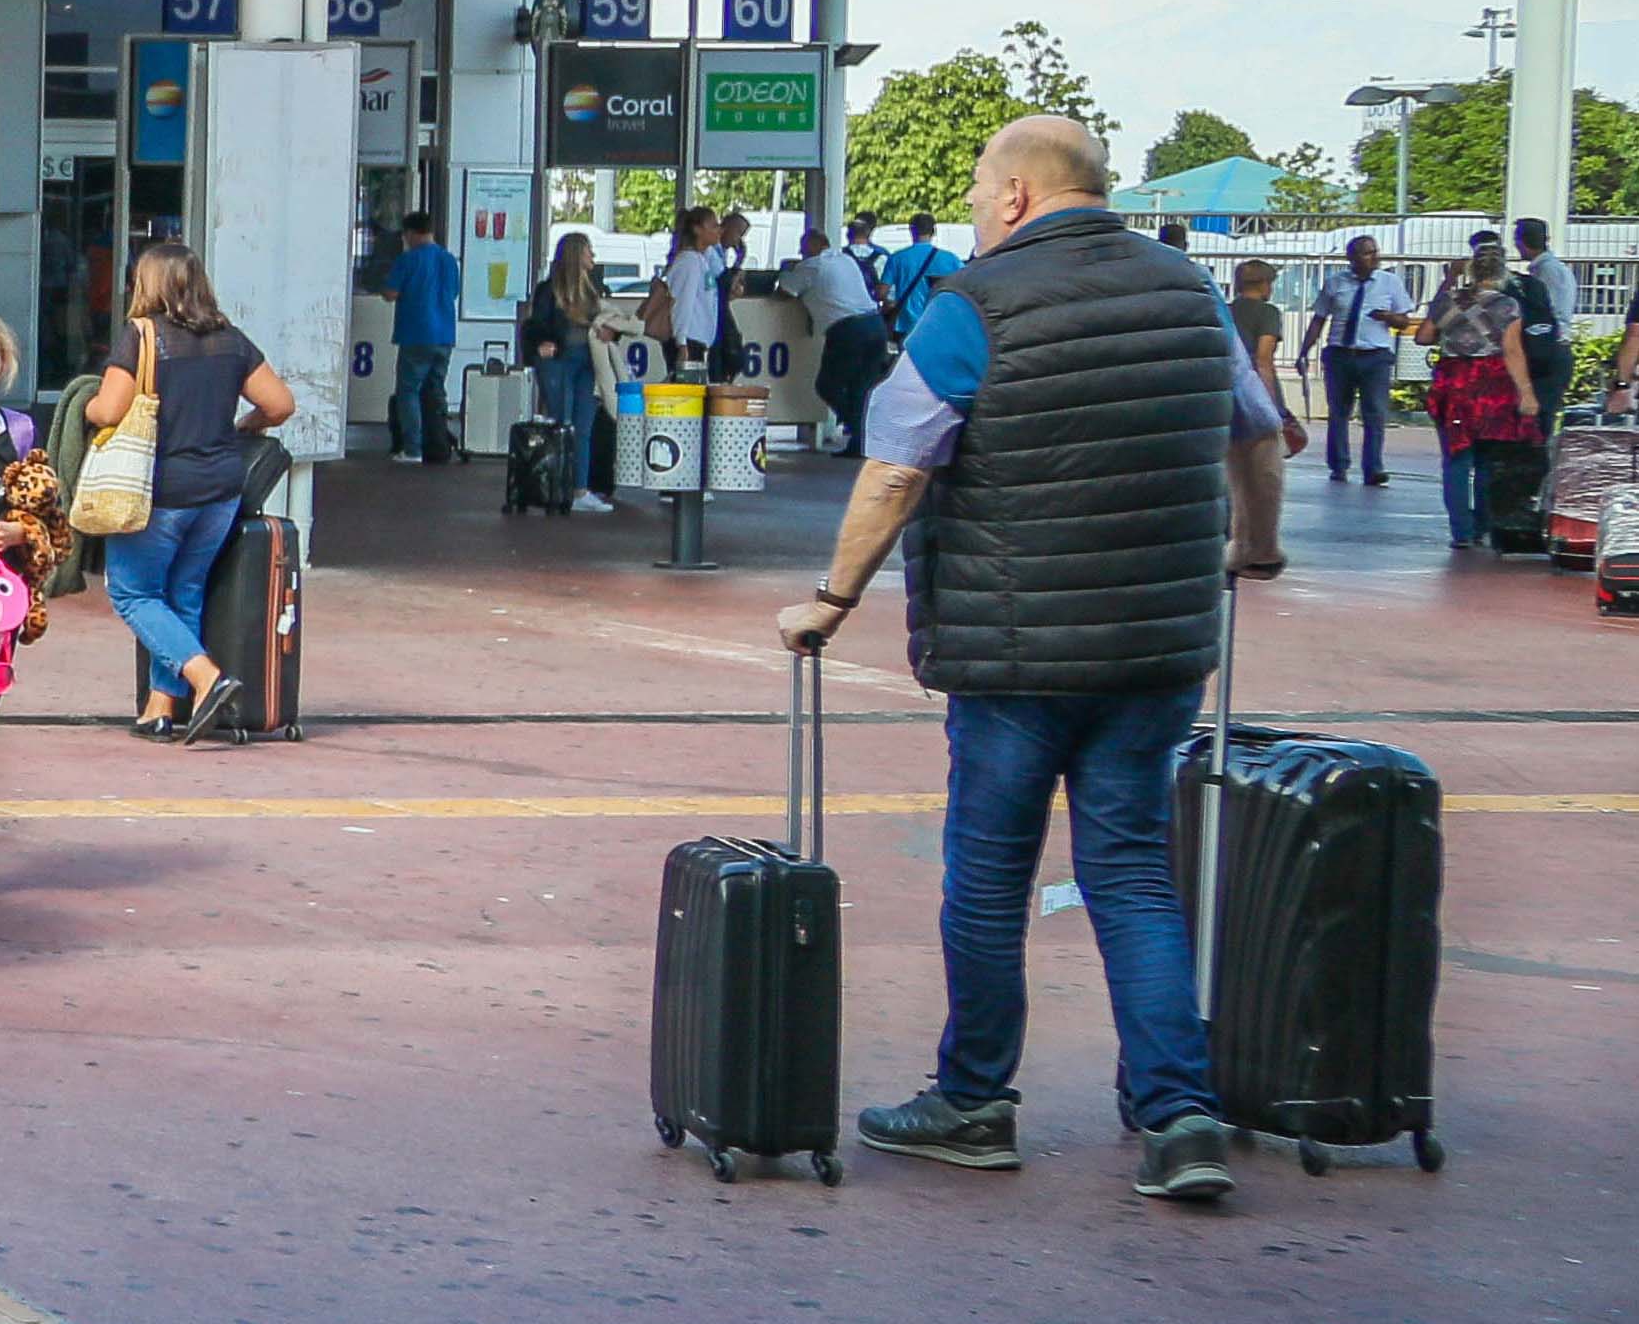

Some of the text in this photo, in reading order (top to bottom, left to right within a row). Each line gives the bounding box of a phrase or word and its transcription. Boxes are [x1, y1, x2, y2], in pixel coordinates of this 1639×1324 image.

[713, 81, 807, 104] ODEON
[606, 95, 674, 117] Coral
[715, 111, 807, 123] TOURS
[742, 341, 790, 378] 60
